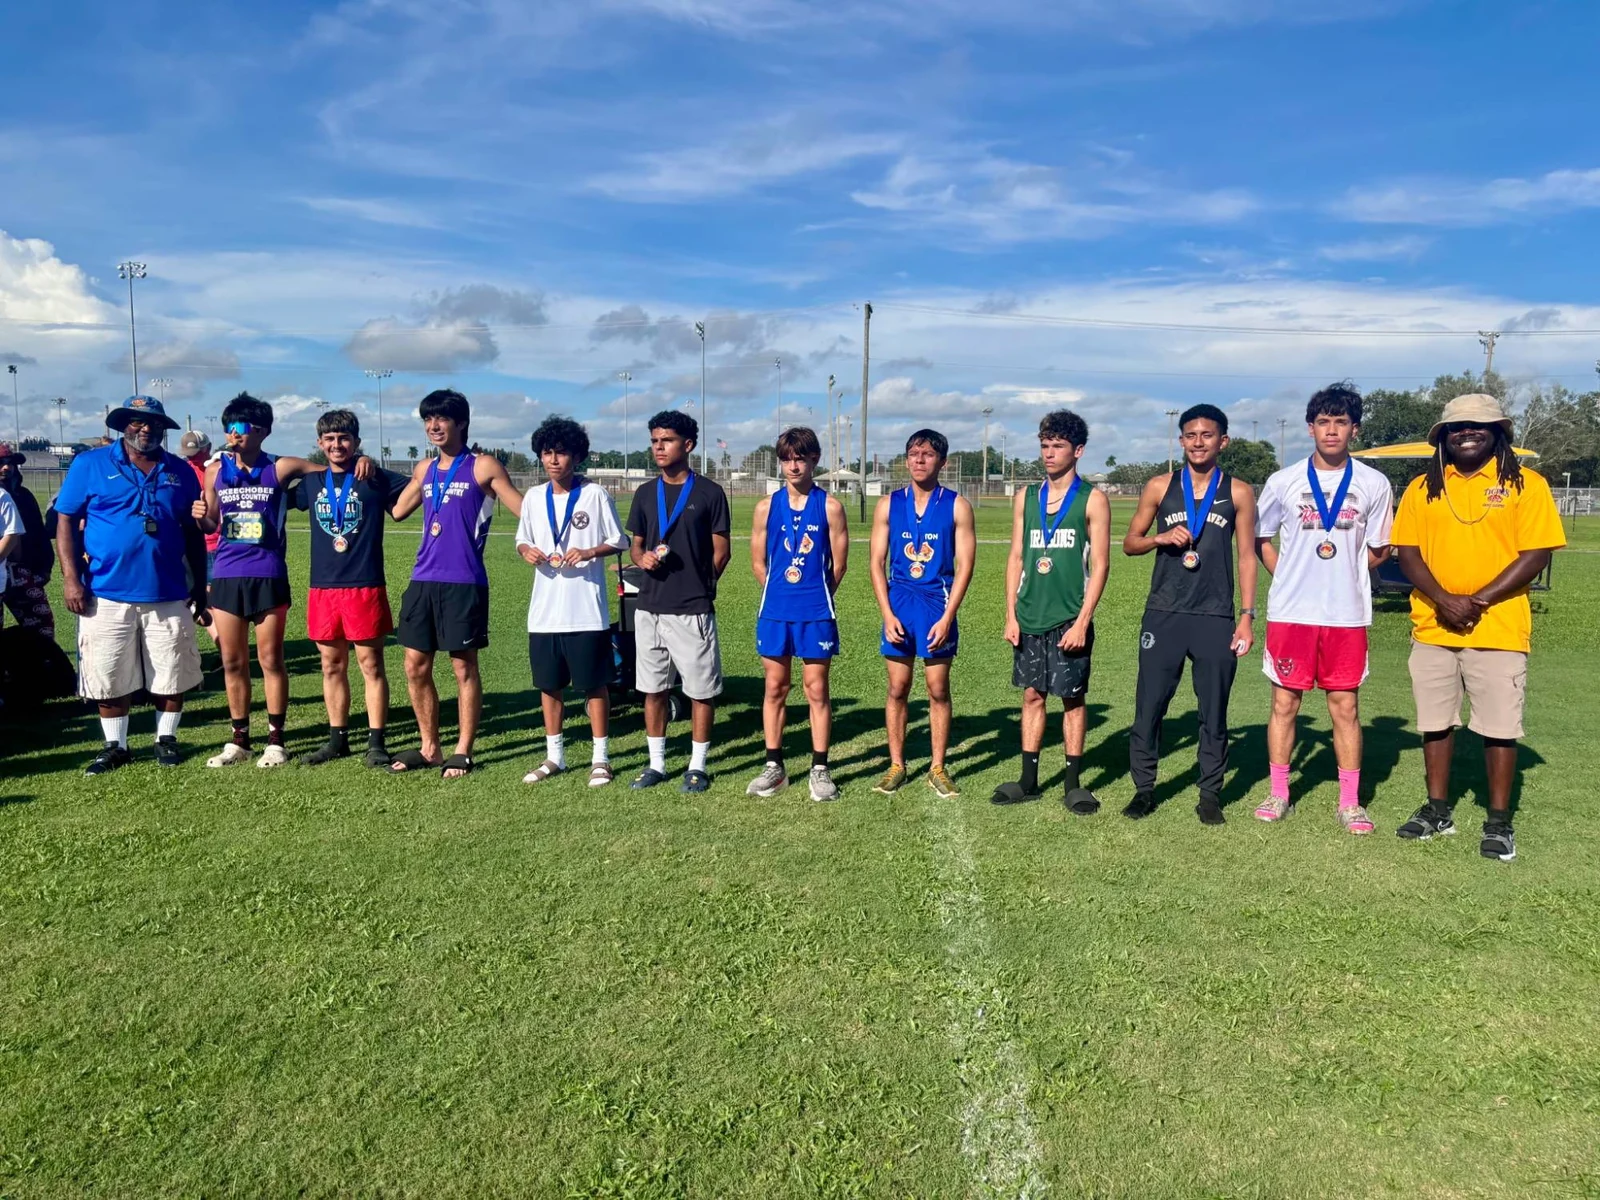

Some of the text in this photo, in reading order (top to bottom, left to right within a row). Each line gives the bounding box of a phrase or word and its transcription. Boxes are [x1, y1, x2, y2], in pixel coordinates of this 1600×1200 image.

[218, 487, 275, 496] OKEECHOBEE
[423, 482, 470, 491] OKCOBEE
[1484, 488, 1510, 498] TIGES
[221, 493, 270, 504] CROSS COUNTRY
[1164, 511, 1228, 528] MOO AVEN
[226, 522, 263, 539] 1539
[901, 531, 939, 540] CLTON
[1030, 528, 1076, 549] DRAONS
